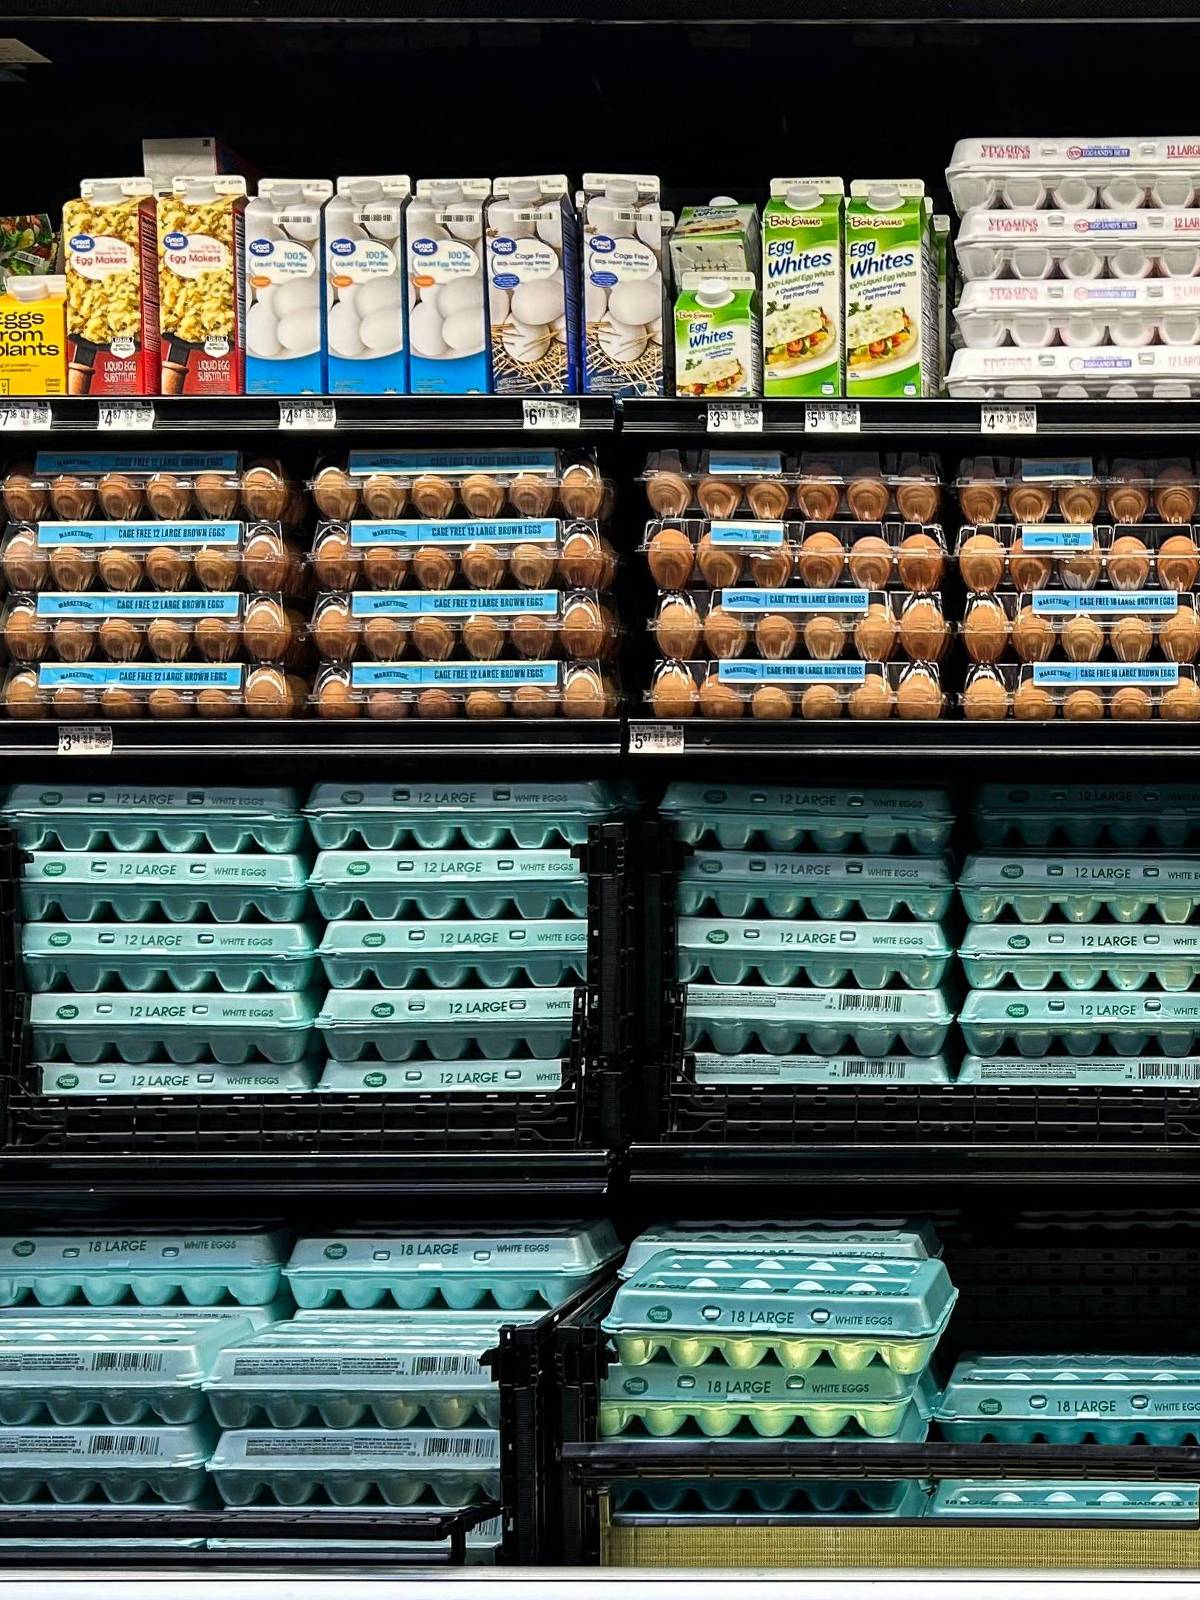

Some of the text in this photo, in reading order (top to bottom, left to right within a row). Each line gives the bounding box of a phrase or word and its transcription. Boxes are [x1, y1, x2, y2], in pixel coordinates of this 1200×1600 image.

[1167, 145, 1174, 155] 12
[770, 216, 822, 226] Bob Evans
[852, 216, 903, 227] Bob Evans
[1174, 218, 1182, 228] 12
[592, 239, 611, 247] Great
[768, 241, 794, 257] Egg
[850, 241, 875, 257] Egg
[76, 256, 127, 265] Egg Makers
[284, 251, 307, 260] 100%
[366, 251, 388, 259] 100%
[768, 253, 832, 278] Whites
[850, 253, 914, 278] Whites
[781, 284, 809, 294] Cholesterol
[679, 312, 692, 320] Bob
[690, 323, 707, 334] Egg
[0, 330, 43, 341] rom
[690, 331, 733, 347] Whites
[104, 362, 136, 371] LIQUID EGG
[104, 373, 136, 382] SUBSTITUTE
[118, 528, 225, 537] CAGE FREE 12 LARGE BROWN EGGS
[431, 526, 541, 537] CAGE FREE 12 LARGE BROWN EGGS
[119, 864, 266, 876] 12 LARGE WHITE EGGS
[780, 933, 793, 942] 12
[796, 933, 836, 943] LARGE
[1081, 936, 1094, 946] 12
[1098, 936, 1137, 946] LARGE
[131, 1075, 146, 1086] 12
[148, 1075, 189, 1086] LARGE
[440, 1073, 454, 1083] 12
[457, 1072, 498, 1083] LARGE
[400, 1244, 413, 1255] 18
[417, 1244, 459, 1255] LARGE
[523, 1244, 549, 1252] EGGS
[731, 1310, 893, 1325] 18 LARGE WHITE EGGS
[1057, 1401, 1070, 1411] 18
[1075, 1401, 1116, 1412] LARGE
[1154, 1402, 1180, 1411] WHITE
